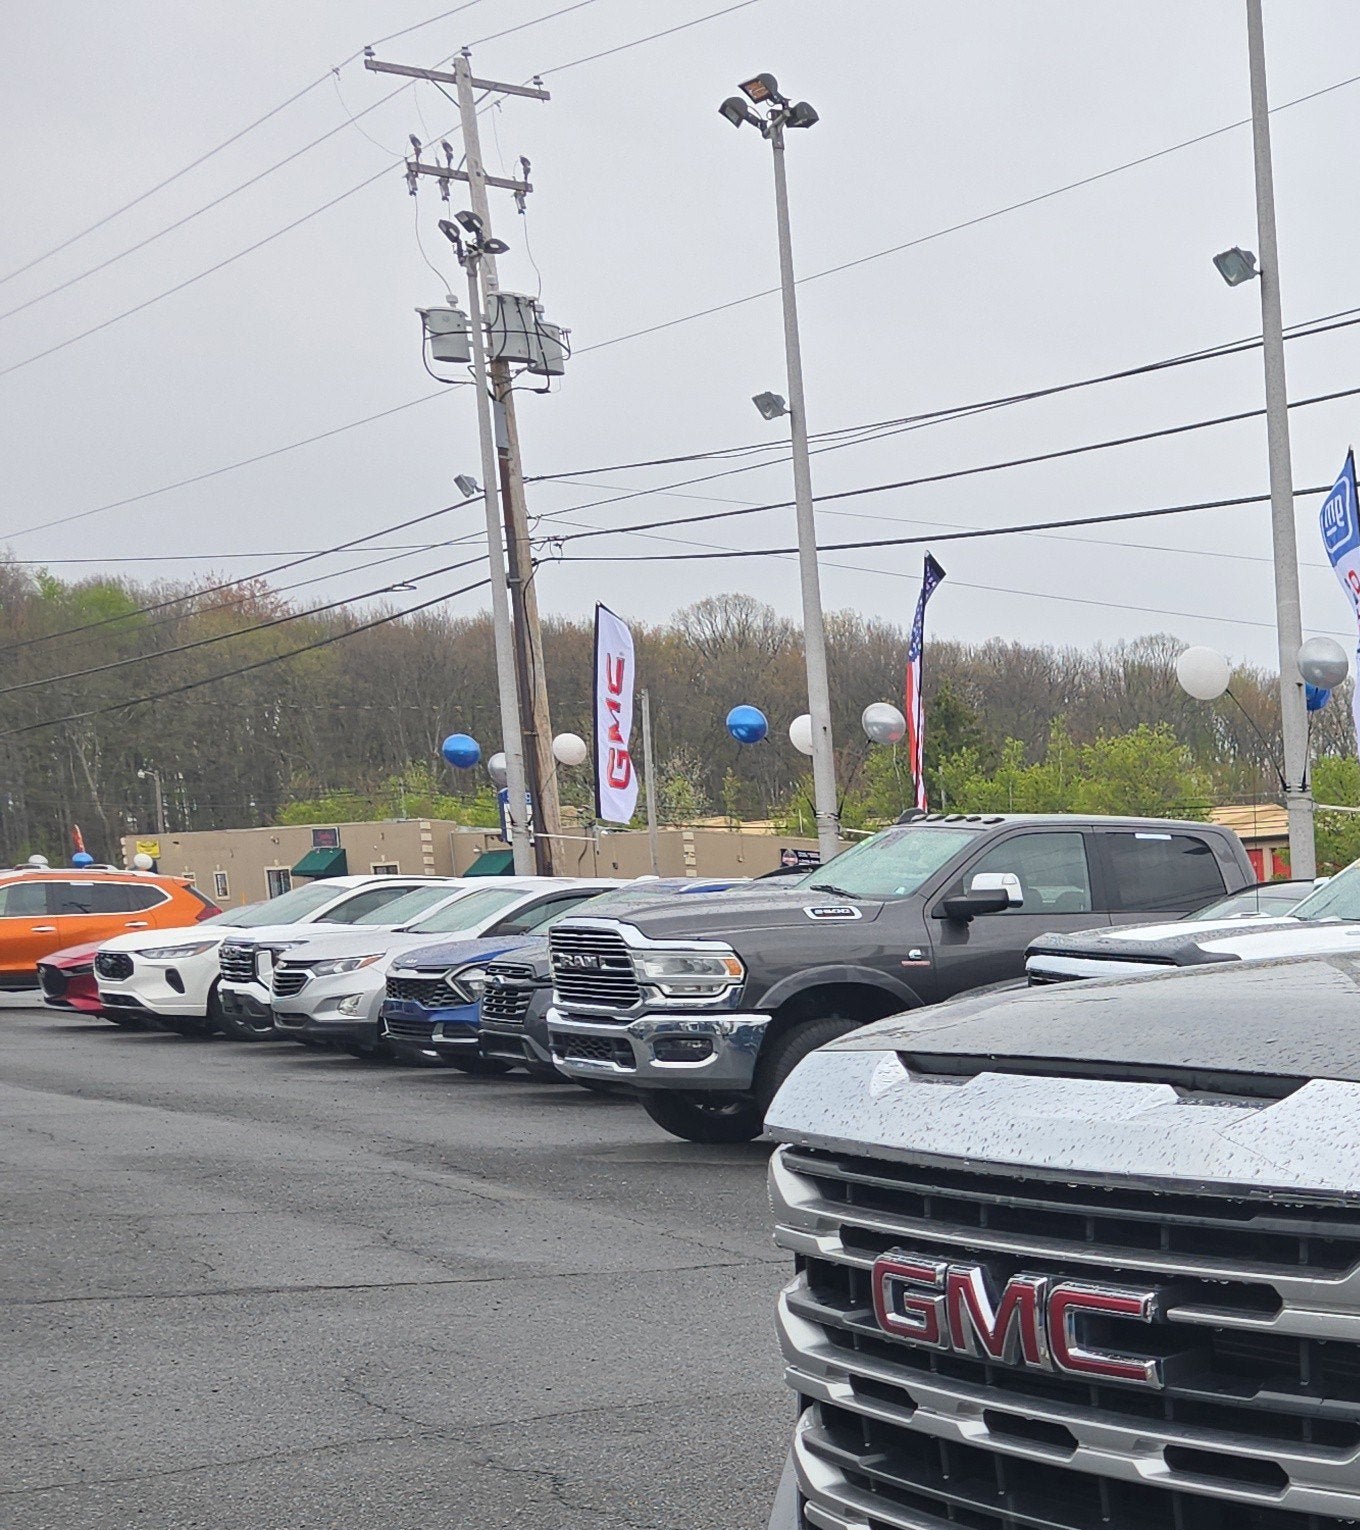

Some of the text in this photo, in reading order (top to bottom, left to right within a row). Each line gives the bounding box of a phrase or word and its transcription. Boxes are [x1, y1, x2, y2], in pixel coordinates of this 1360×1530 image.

[605, 652, 631, 789] GMC
[560, 954, 598, 968] RAM
[872, 1249, 1165, 1390] GMC
